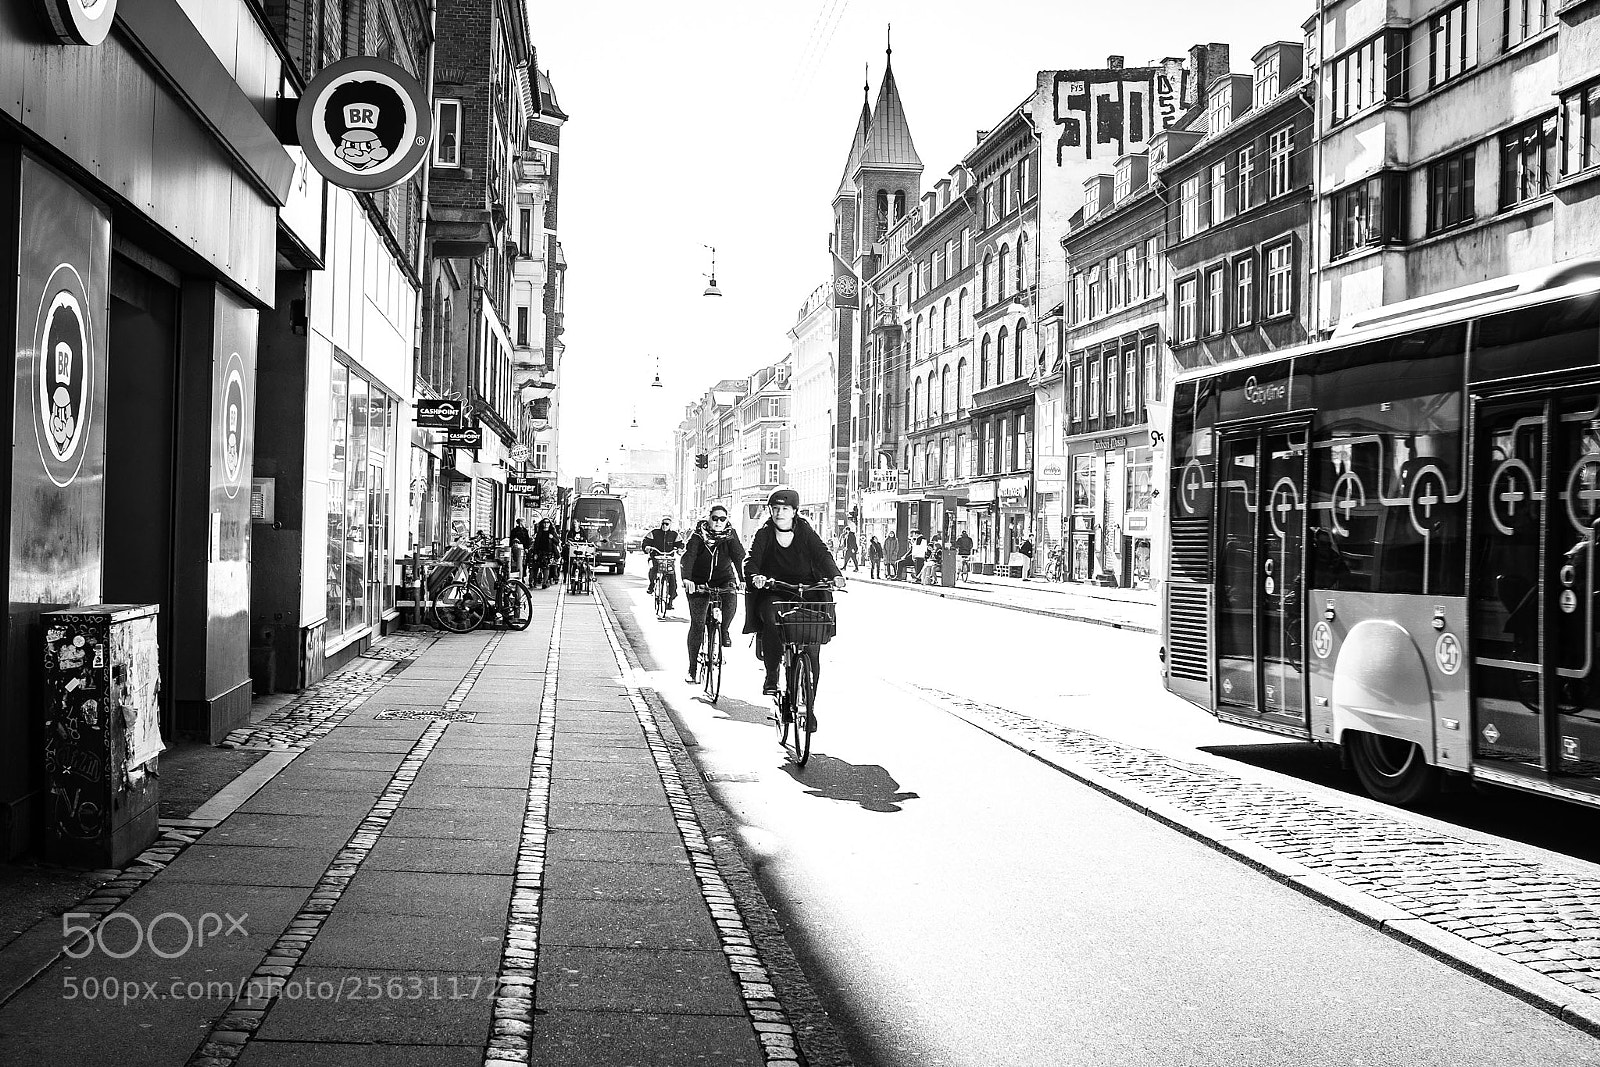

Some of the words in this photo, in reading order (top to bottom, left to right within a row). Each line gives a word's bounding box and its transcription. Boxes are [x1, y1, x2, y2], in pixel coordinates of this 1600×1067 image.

[349, 108, 374, 124] BR
[58, 351, 69, 378] BR
[420, 408, 459, 416] CASHPOINT
[508, 483, 536, 493] burger
